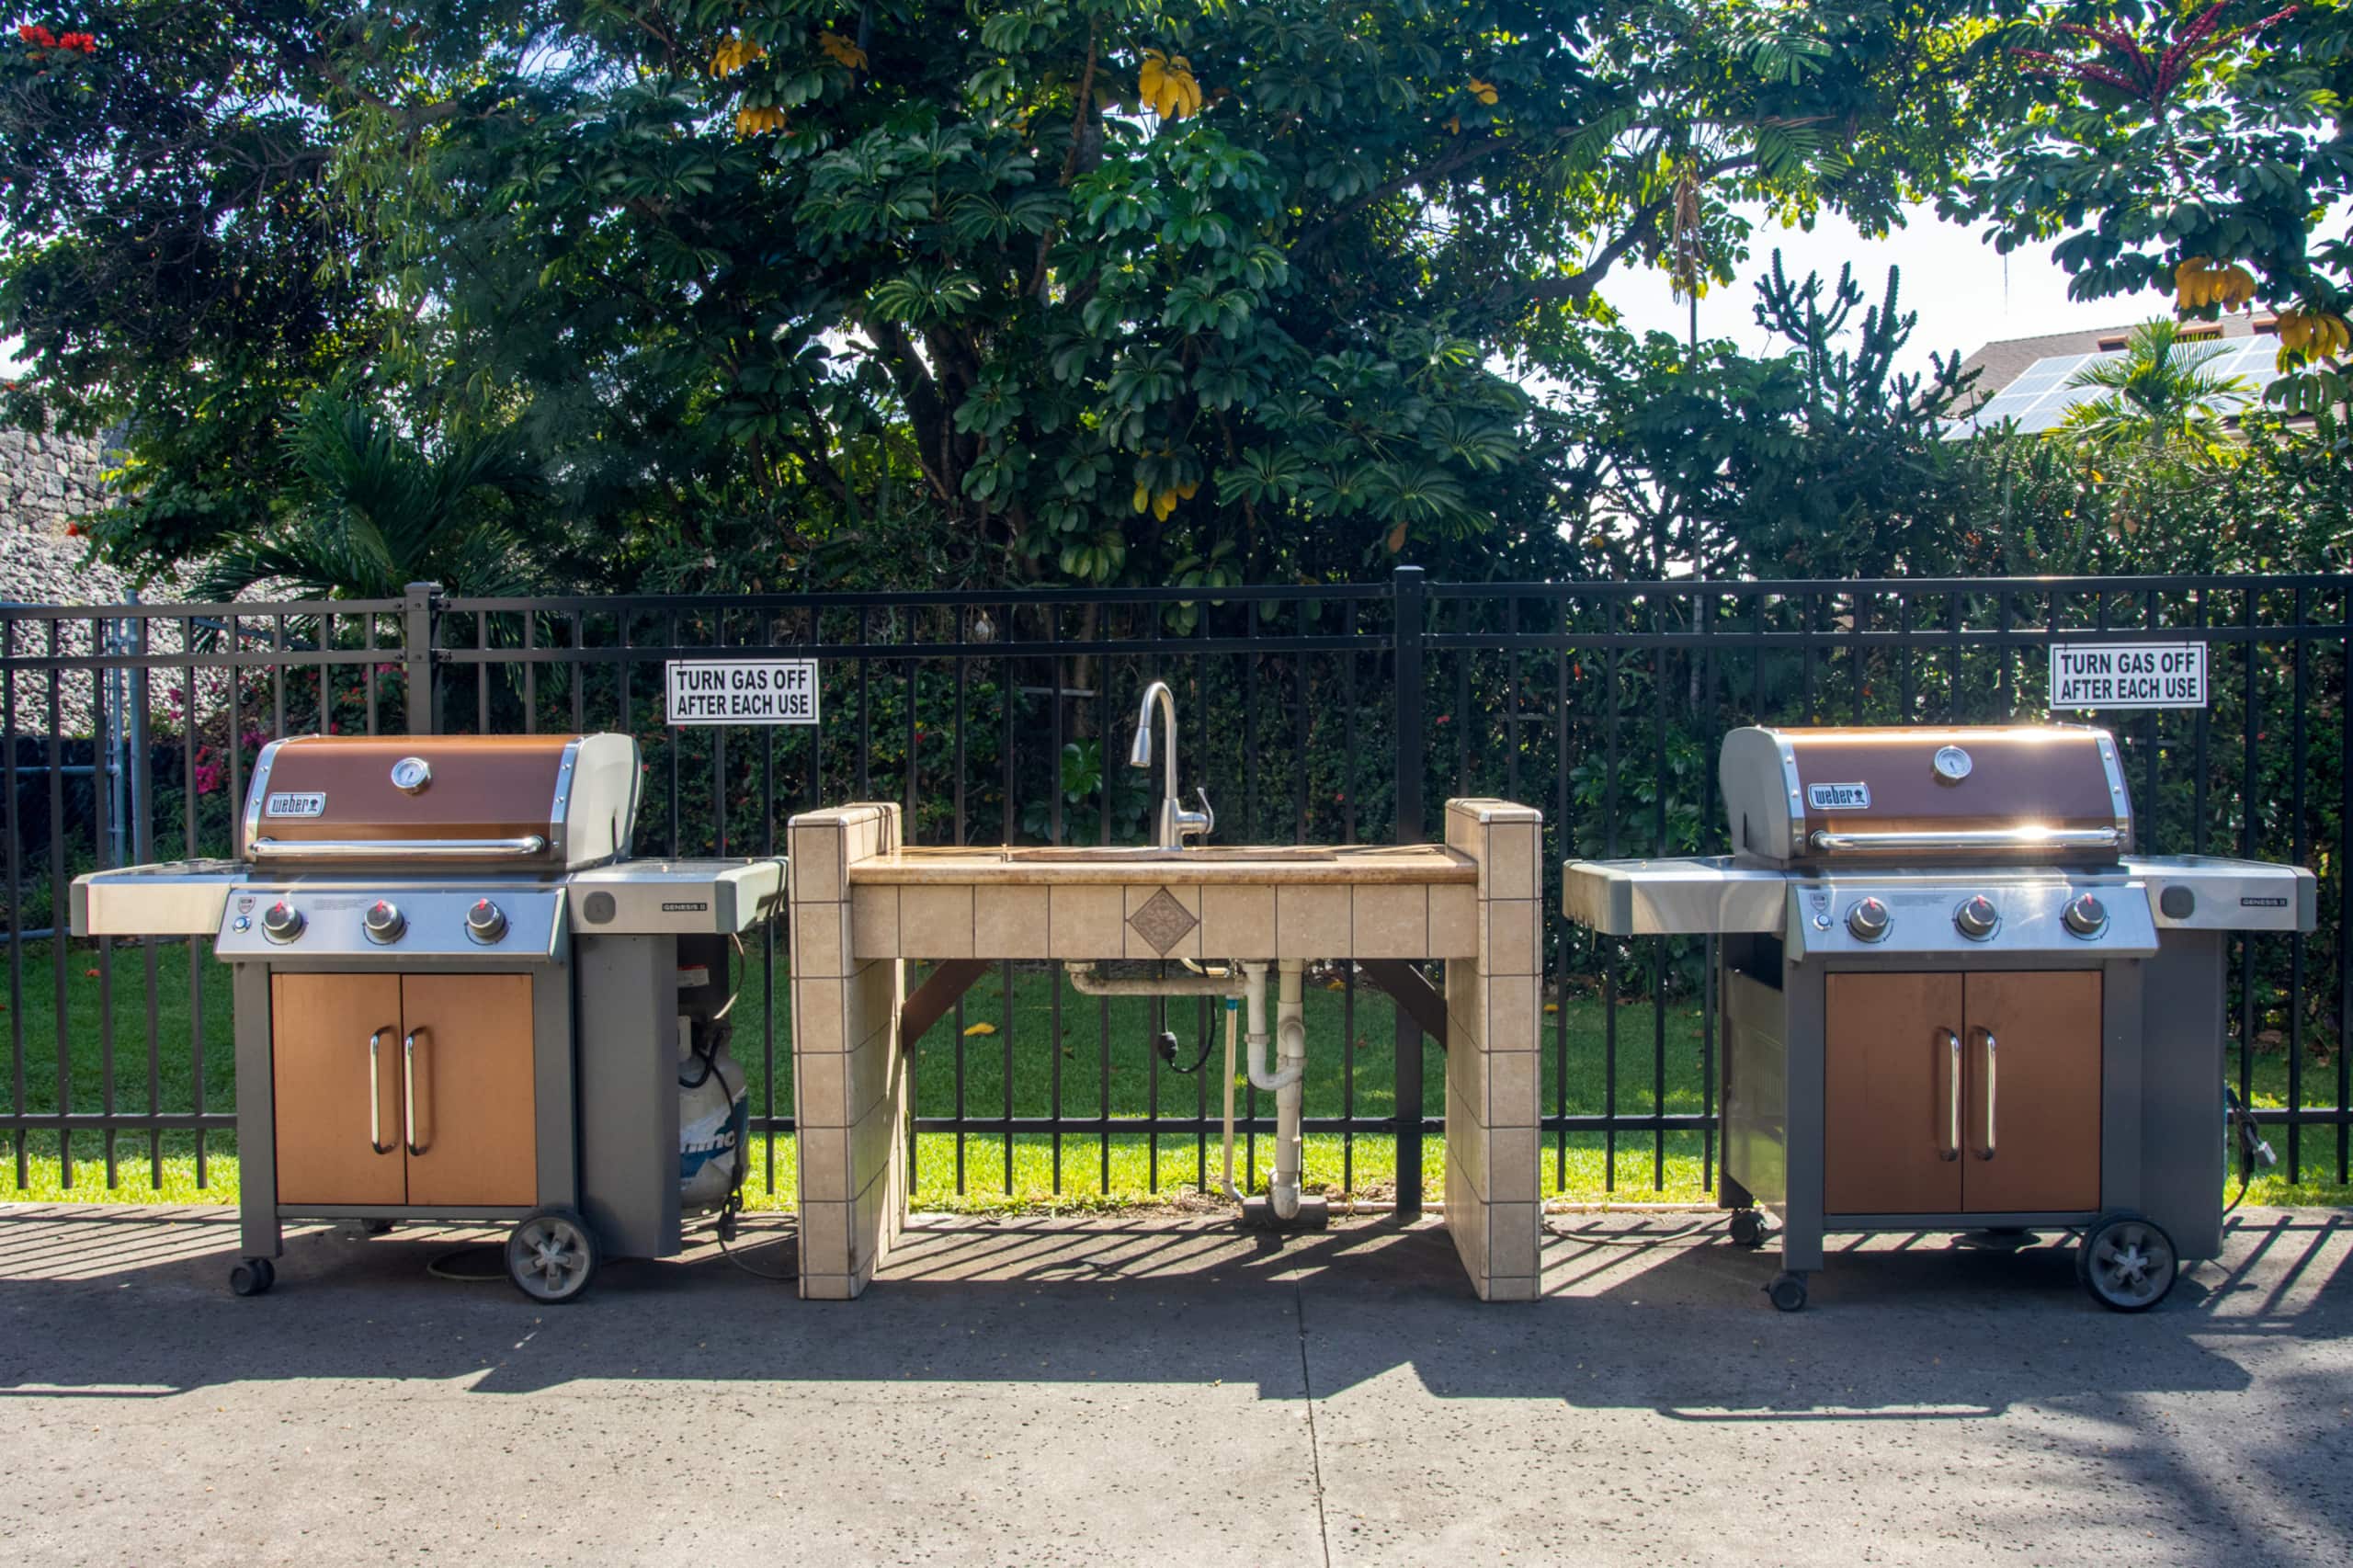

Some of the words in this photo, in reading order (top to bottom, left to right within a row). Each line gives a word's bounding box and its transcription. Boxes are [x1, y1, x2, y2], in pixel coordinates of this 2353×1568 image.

[2061, 653, 2111, 675] TURN
[2118, 653, 2154, 674] GAS
[2161, 652, 2195, 673] OFF
[676, 670, 725, 690] TURN
[732, 669, 767, 690] GAS
[774, 669, 807, 689] OFF
[2061, 679, 2112, 699] AFTER
[2118, 678, 2160, 699] EACH
[2165, 677, 2197, 699] USE
[676, 695, 727, 715] AFTER
[732, 694, 773, 714] EACH
[779, 694, 809, 714] USE
[271, 793, 310, 813] weber
[1814, 785, 1853, 804] weber
